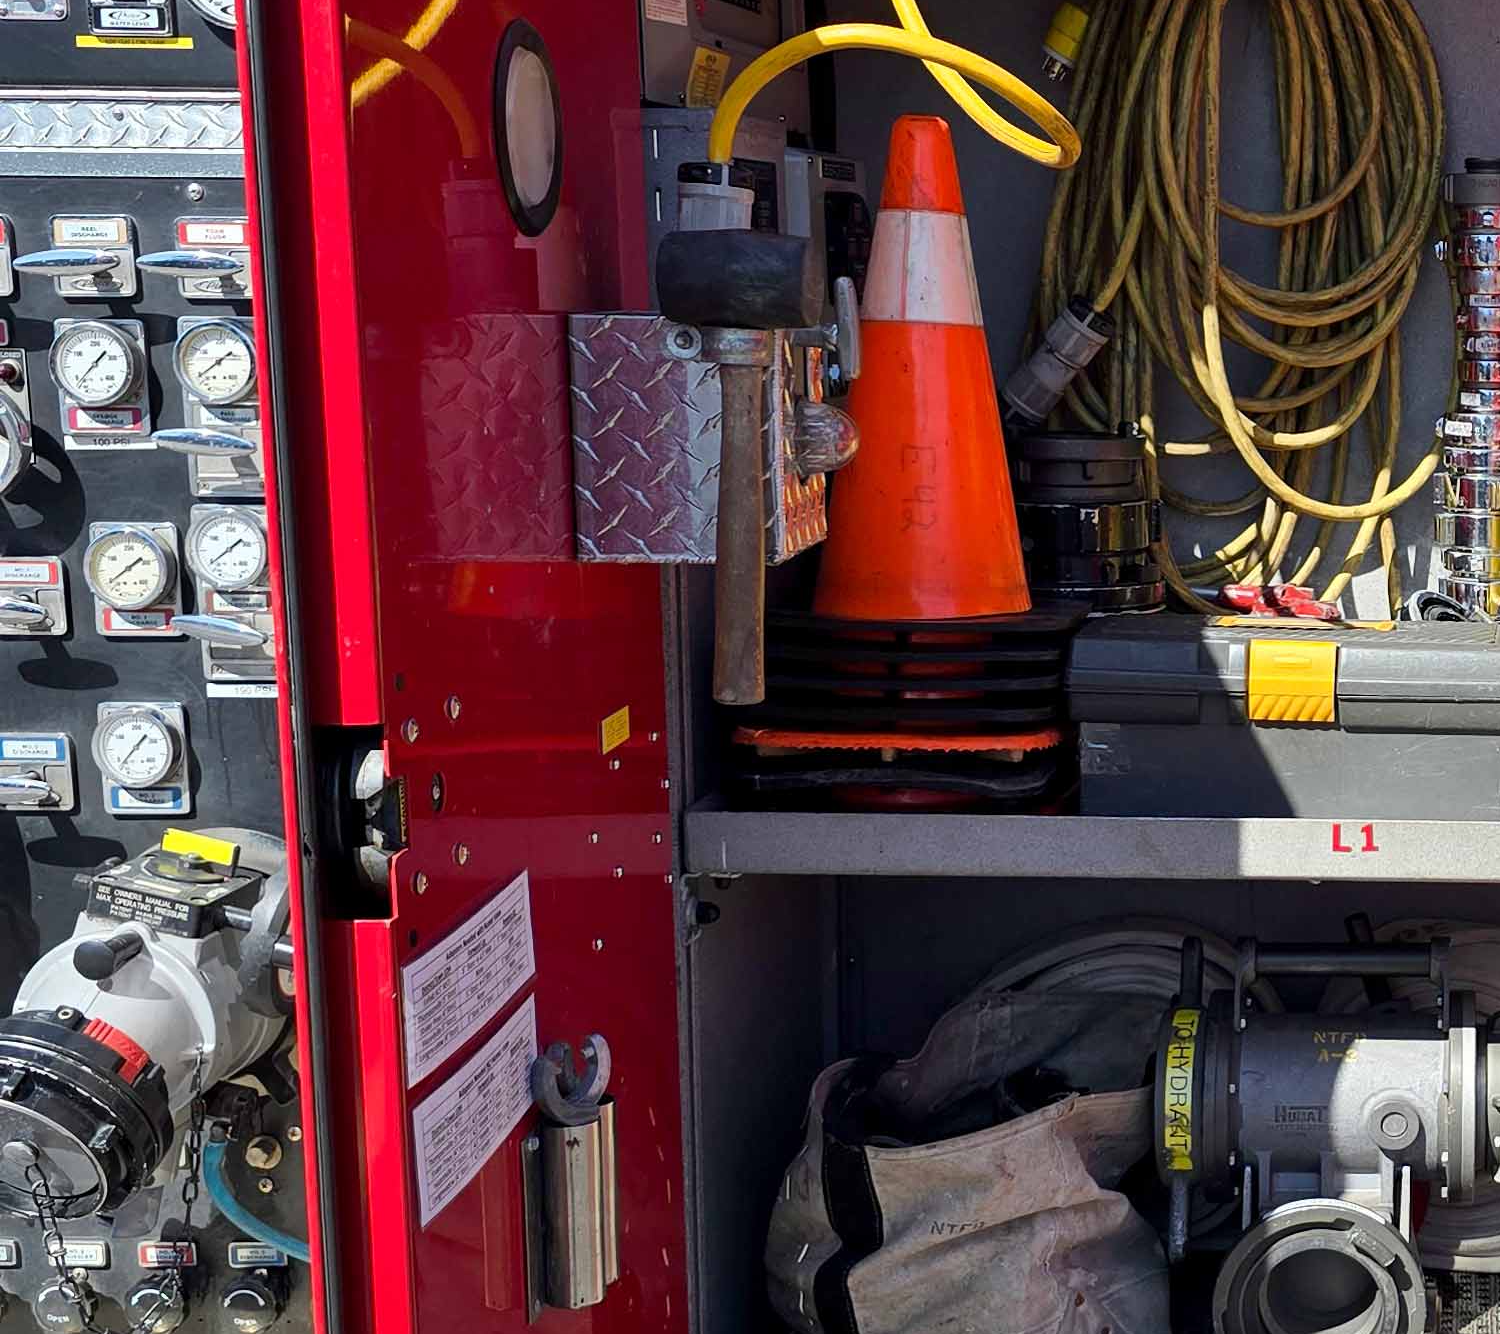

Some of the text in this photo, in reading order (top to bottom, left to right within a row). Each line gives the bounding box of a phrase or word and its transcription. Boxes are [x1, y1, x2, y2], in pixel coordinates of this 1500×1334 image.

[93, 438, 111, 446] 100
[1332, 822, 1379, 853] L1
[96, 893, 112, 902] MAX
[114, 897, 151, 912] OPERATING
[1169, 1020, 1194, 1150] TO HYDRANT
